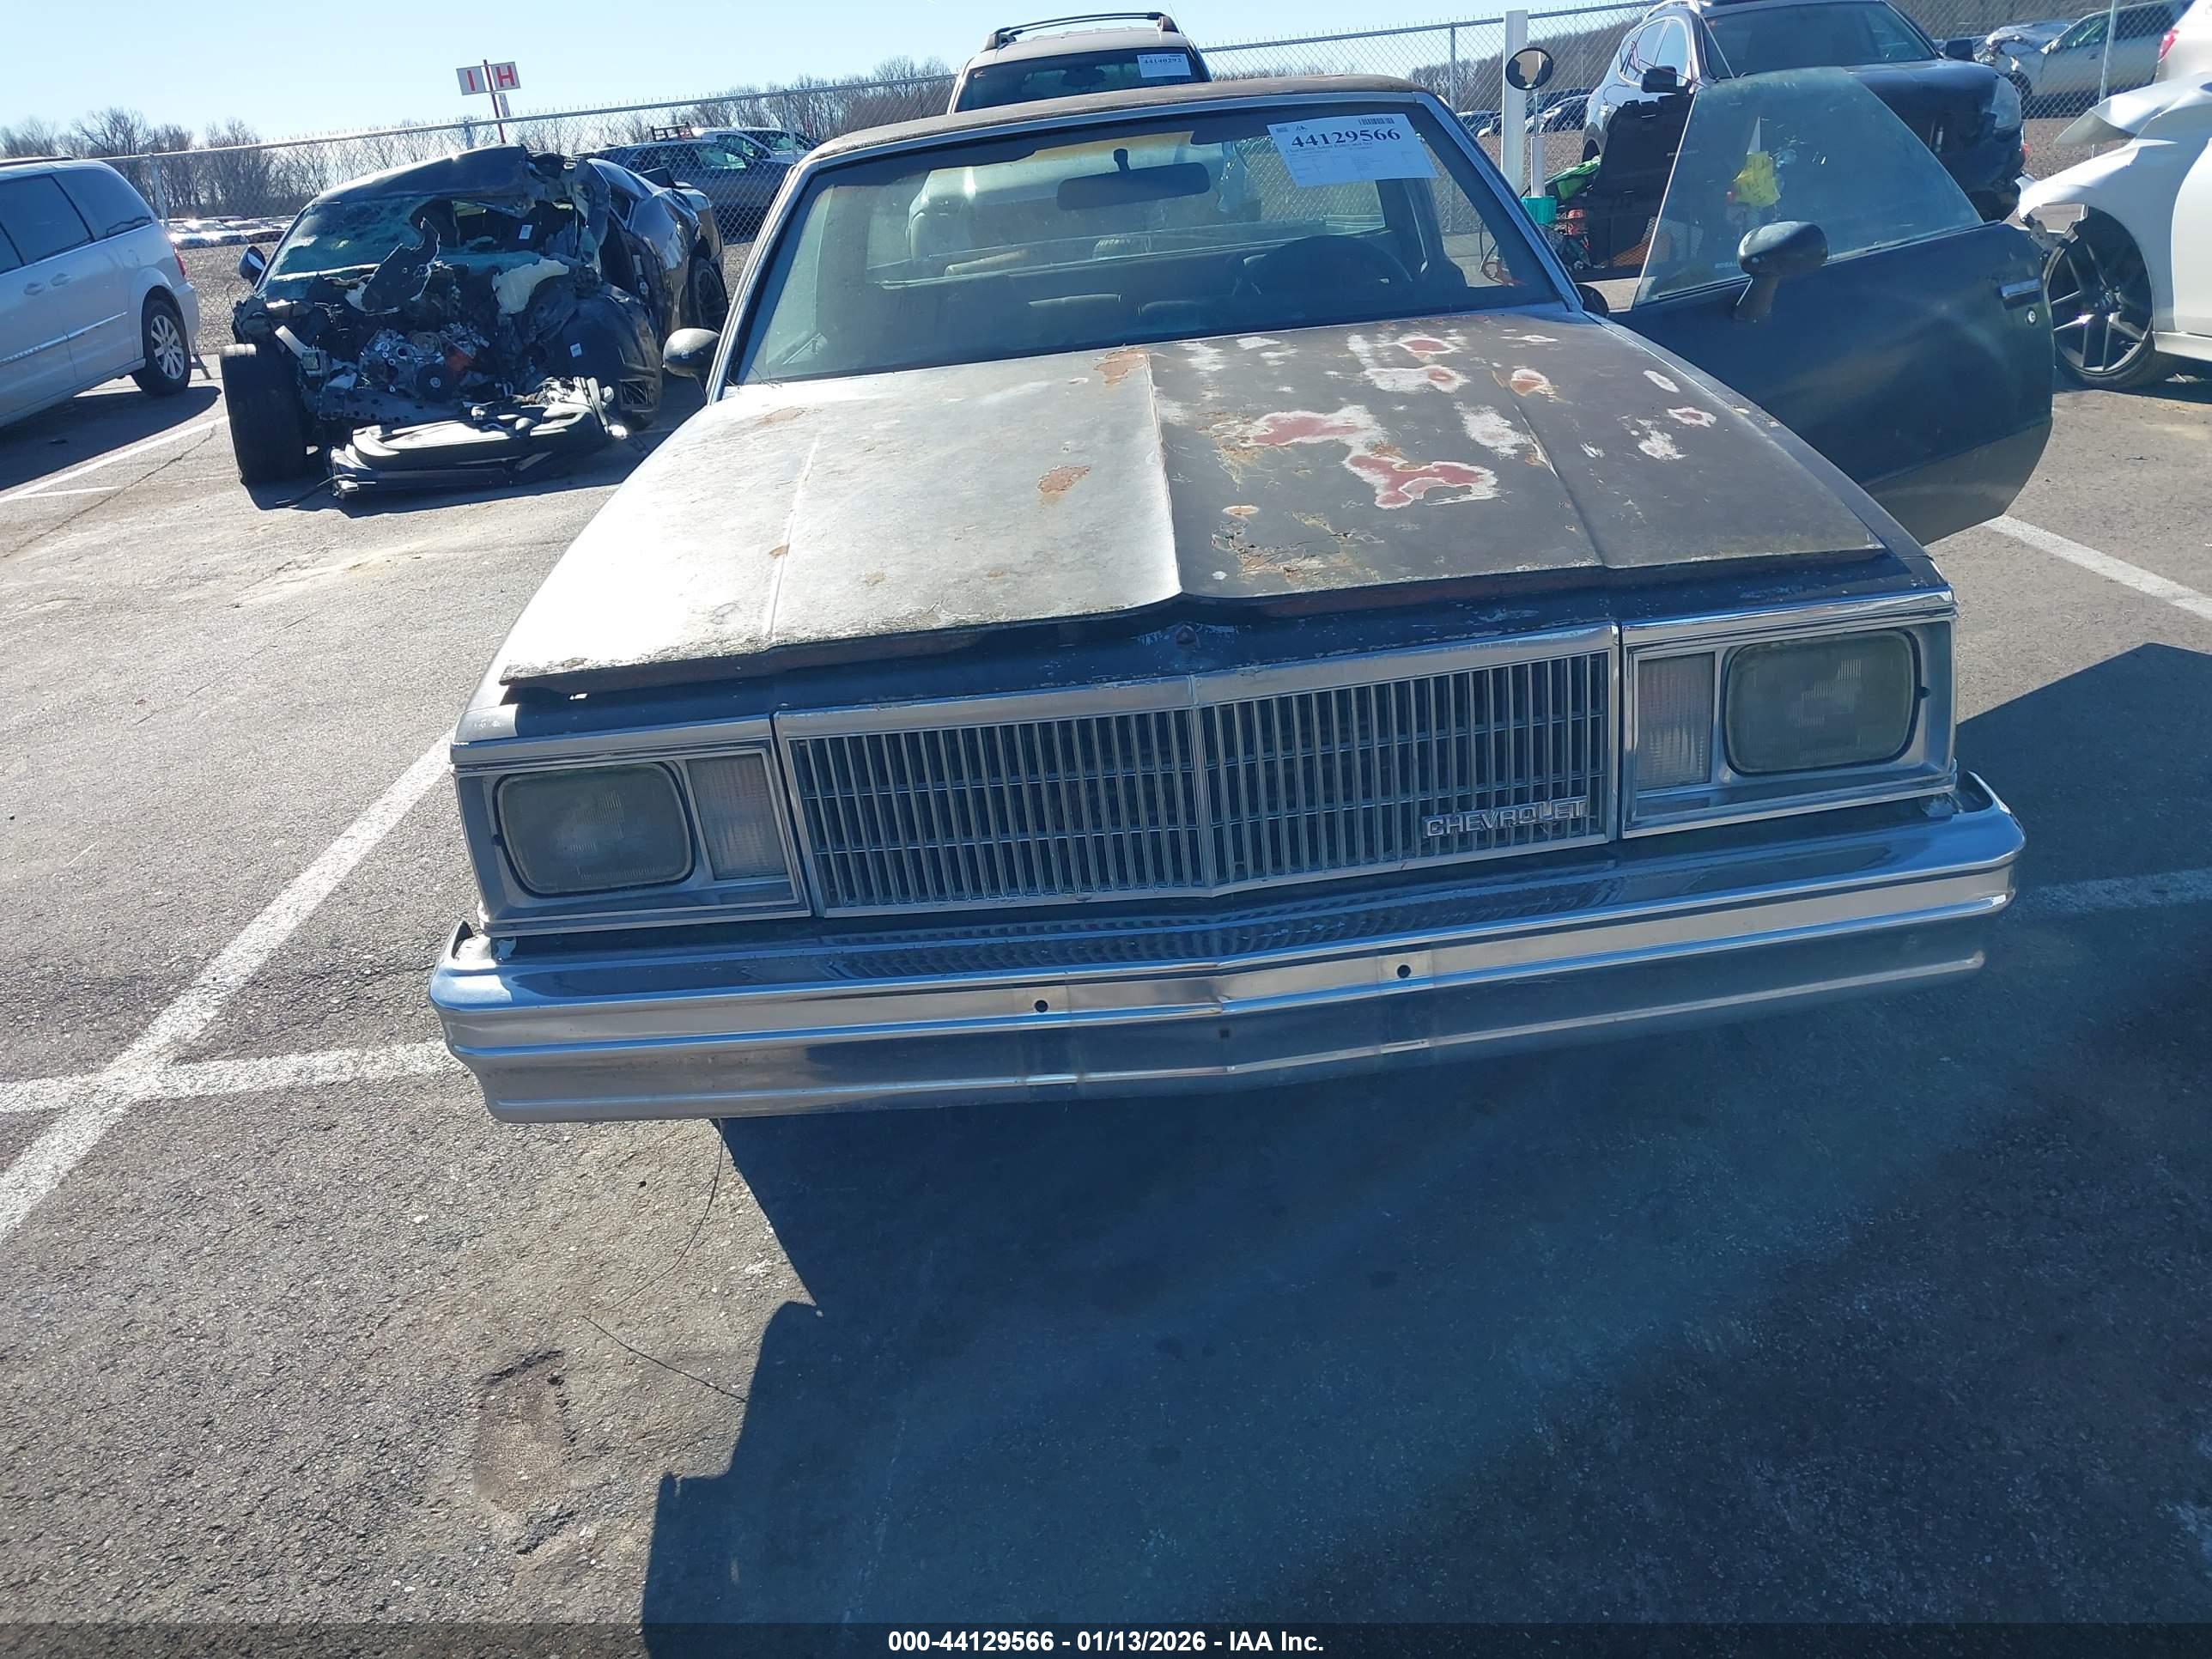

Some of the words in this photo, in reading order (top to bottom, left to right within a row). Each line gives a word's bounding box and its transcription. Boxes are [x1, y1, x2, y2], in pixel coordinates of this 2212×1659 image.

[466, 70, 476, 92] I
[495, 64, 515, 88] H
[1291, 128, 1401, 149] 44129566
[1425, 799, 1588, 837] CHEVROLET
